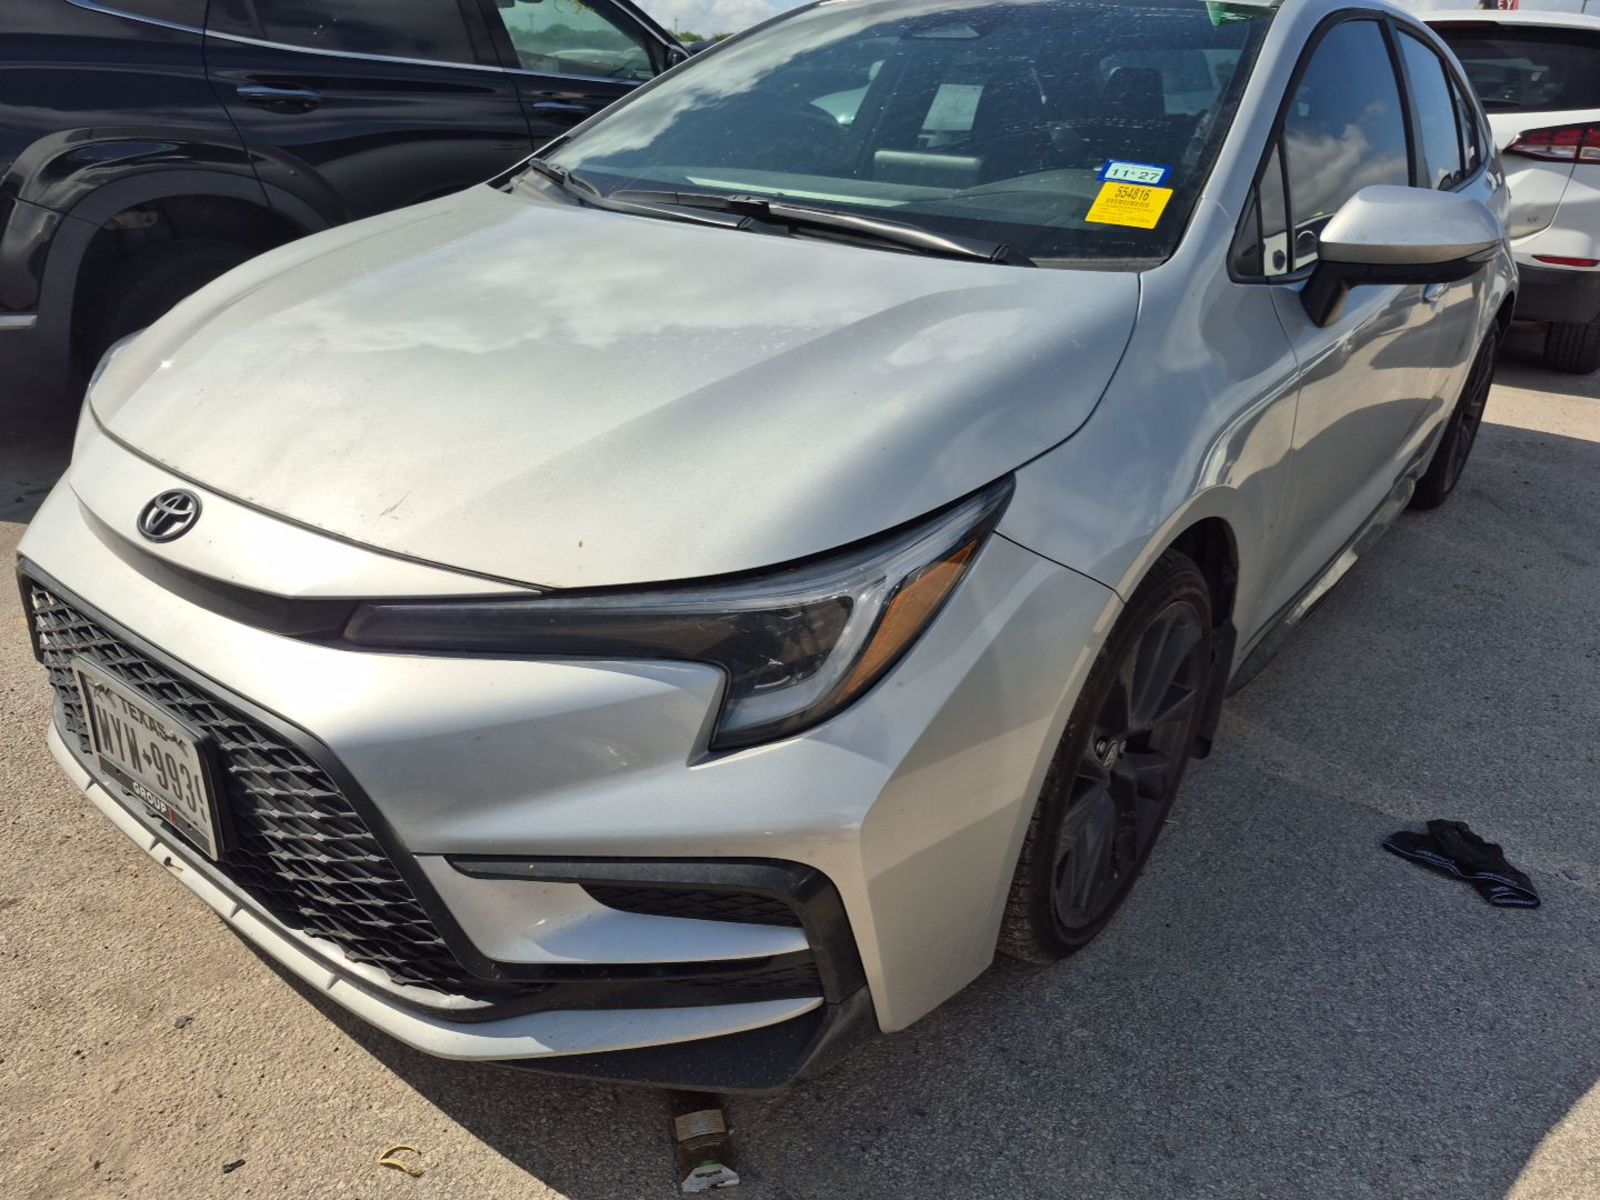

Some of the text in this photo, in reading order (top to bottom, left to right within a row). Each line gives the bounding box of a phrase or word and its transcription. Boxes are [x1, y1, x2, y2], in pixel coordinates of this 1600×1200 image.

[1112, 168, 1160, 181] 11 27
[1115, 186, 1152, 201] 554816
[121, 697, 167, 742] TEXAS
[132, 781, 168, 813] GROUP
